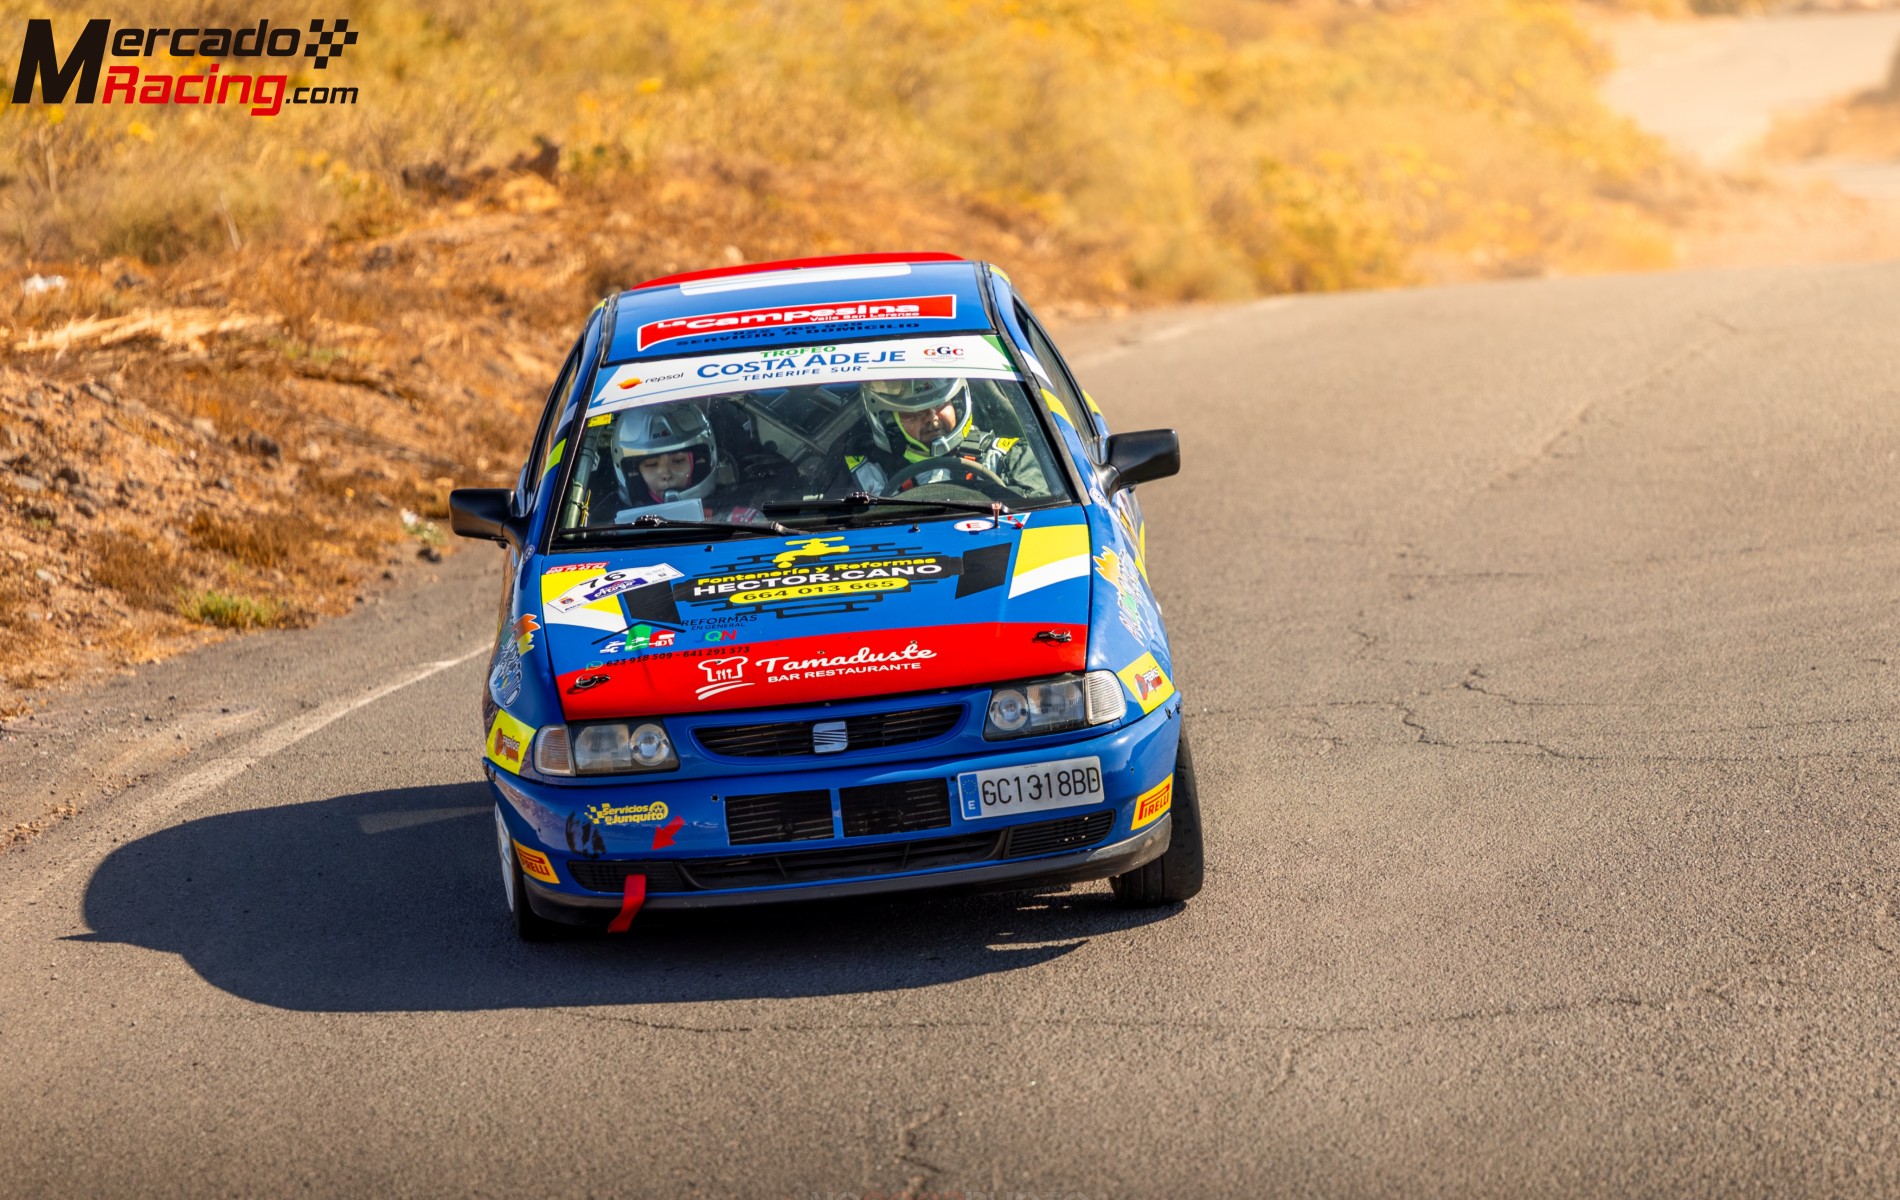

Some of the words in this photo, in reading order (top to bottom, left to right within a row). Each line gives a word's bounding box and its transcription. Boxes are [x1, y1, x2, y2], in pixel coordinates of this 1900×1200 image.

[657, 320, 687, 329] La
[810, 314, 839, 322] Valle
[805, 322, 920, 335] DOMICILIO
[760, 345, 836, 358] TROFEO
[923, 346, 964, 356] GGC
[697, 357, 797, 379] COSTA
[804, 350, 906, 367] ADEJE
[644, 372, 684, 385] repsol
[742, 368, 820, 382] TENERIFE
[830, 365, 862, 374] SUR
[815, 566, 830, 575] y
[834, 557, 937, 572] Reformas
[579, 571, 627, 589] 76
[693, 564, 943, 597] HECTOR.CANO
[743, 589, 790, 602] 664
[798, 584, 841, 596] 013
[849, 580, 895, 591] 665
[681, 614, 758, 627] REFORMAS
[705, 622, 746, 630] GENERAL
[606, 658, 627, 667] 623
[652, 652, 673, 661] 509
[683, 650, 703, 659] 641
[706, 647, 727, 656] 291
[730, 645, 750, 654] 573
[755, 642, 938, 673] Tamaduste
[767, 672, 800, 683] BAR
[804, 662, 922, 679] RESTAURANTE
[602, 804, 649, 816] Servicios
[967, 800, 976, 810] E
[1138, 783, 1171, 821] PIRELLI
[518, 849, 551, 877] PIRELLI
